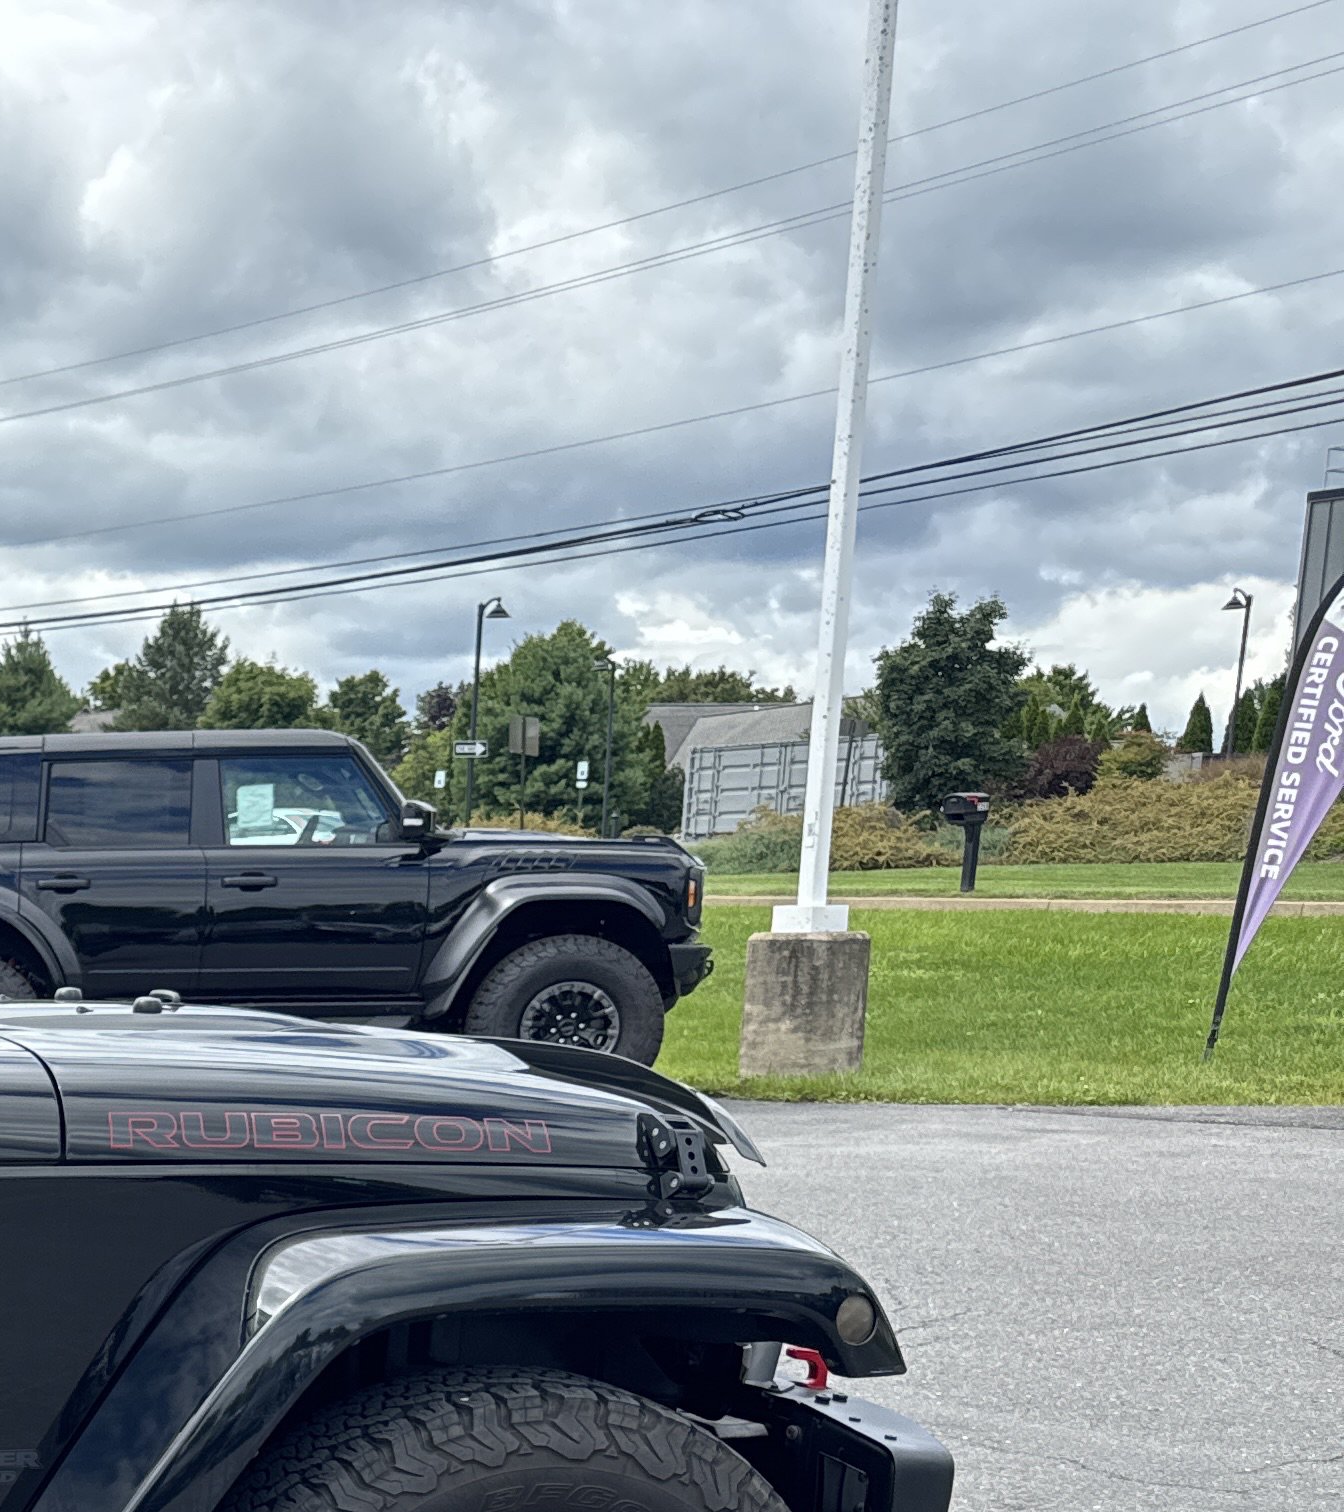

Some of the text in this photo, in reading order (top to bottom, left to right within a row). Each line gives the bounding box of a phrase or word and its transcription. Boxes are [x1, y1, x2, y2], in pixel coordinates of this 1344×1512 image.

[1260, 636, 1339, 881] CERTIFIED SERVICE
[1316, 672, 1344, 778] ord
[109, 1111, 552, 1153] RUBICON
